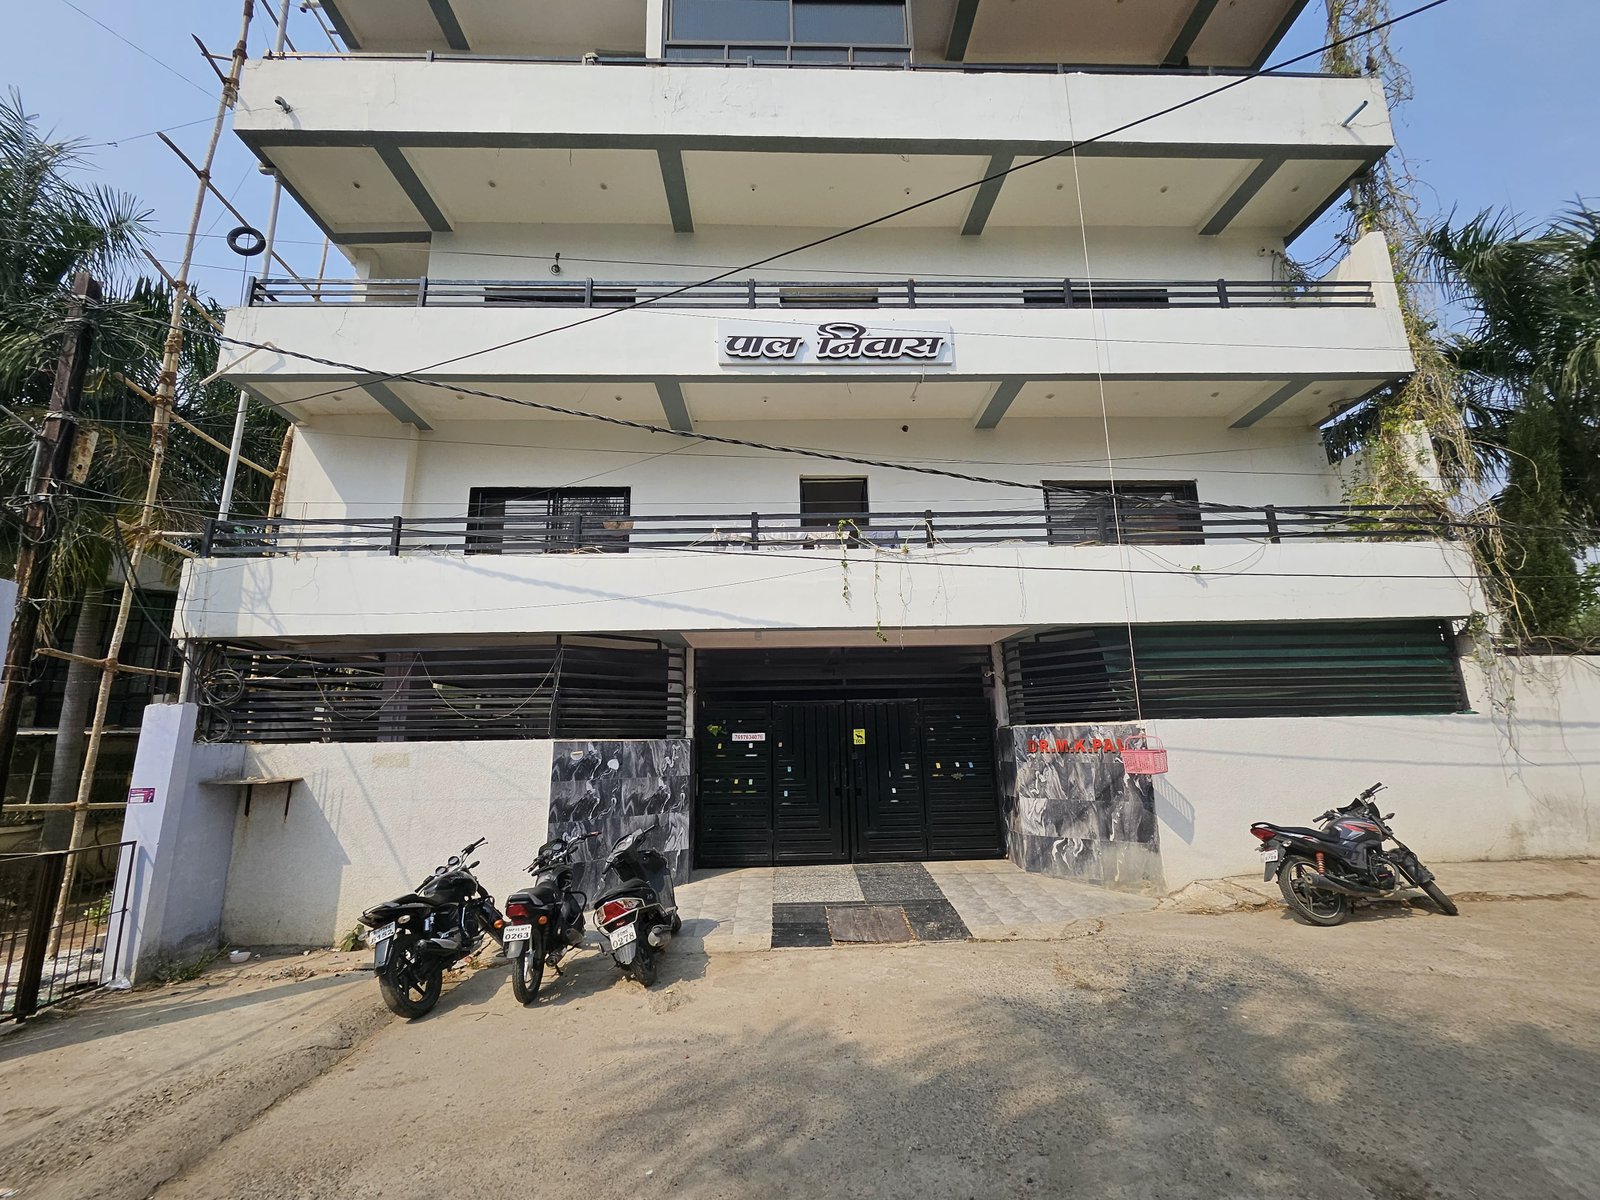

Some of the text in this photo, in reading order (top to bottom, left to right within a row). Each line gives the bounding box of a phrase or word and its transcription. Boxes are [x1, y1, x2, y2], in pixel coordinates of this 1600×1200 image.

[725, 322, 945, 359] पाल निवास
[504, 932, 529, 940] 0263
[612, 932, 635, 949] 0278
